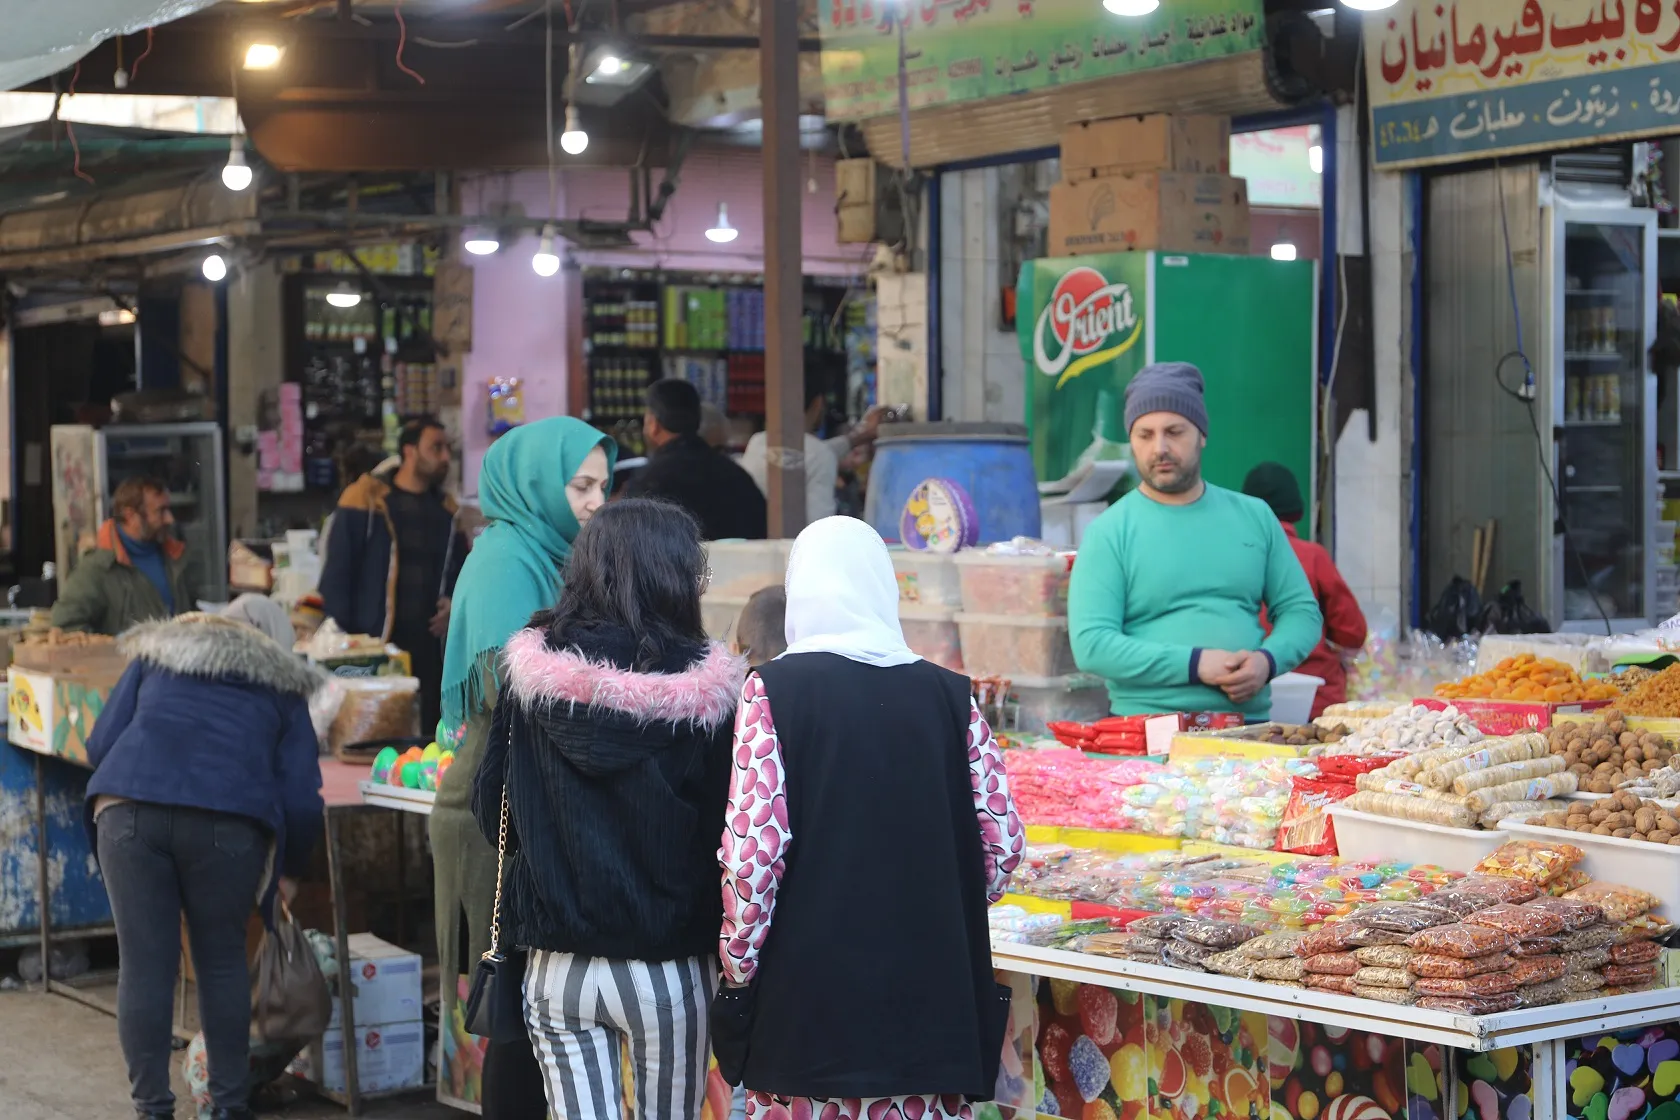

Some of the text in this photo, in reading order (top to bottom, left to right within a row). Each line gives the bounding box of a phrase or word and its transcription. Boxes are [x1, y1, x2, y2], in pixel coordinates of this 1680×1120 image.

[1450, 98, 1526, 142] معلبات
[1547, 85, 1620, 127] زيتون
[1033, 283, 1138, 376] Orient
